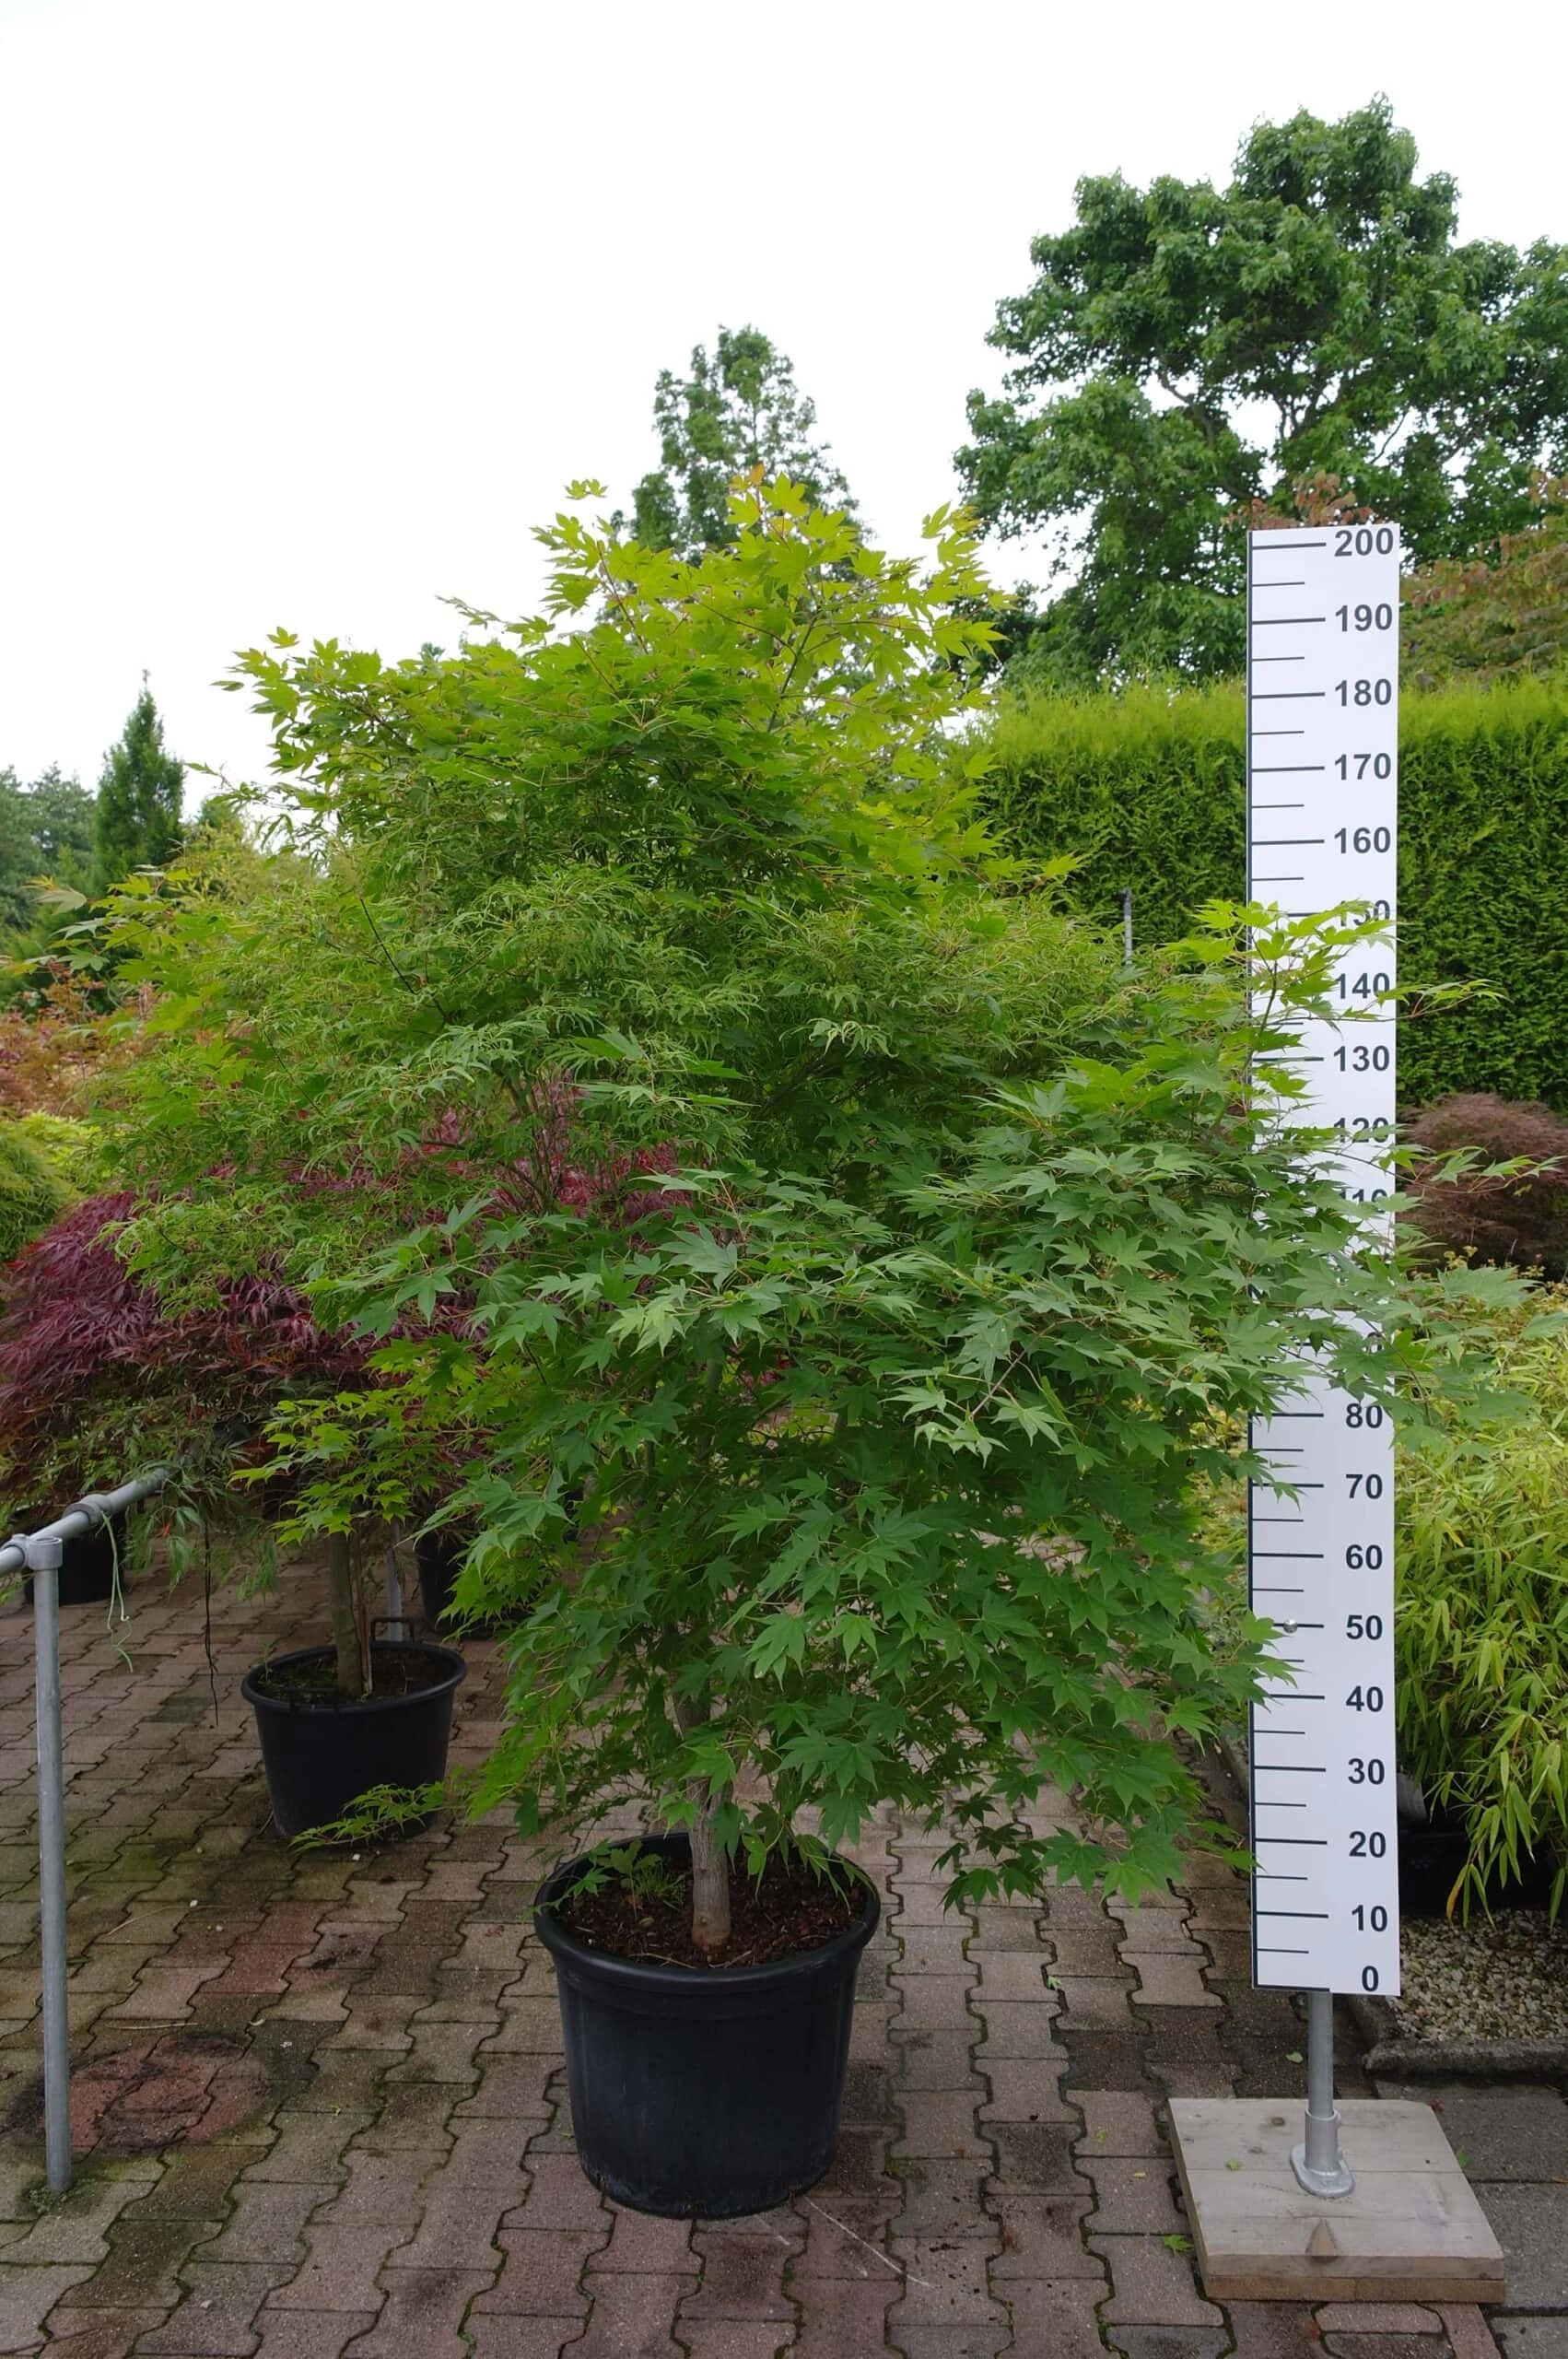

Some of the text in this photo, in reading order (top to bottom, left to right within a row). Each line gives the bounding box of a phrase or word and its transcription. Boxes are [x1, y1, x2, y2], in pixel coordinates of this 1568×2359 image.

[1334, 527, 1394, 557] 200
[1334, 604, 1392, 632] 190
[1334, 678, 1392, 707] 180
[1334, 753, 1391, 781] 170
[1334, 827, 1391, 854] 160
[1335, 972, 1390, 999] 140
[1333, 1045, 1390, 1072] 130
[1345, 1402, 1383, 1429] 80
[1345, 1473, 1383, 1500] 70
[1345, 1543, 1383, 1570] 60
[1346, 1614, 1383, 1640] 50
[1345, 1685, 1384, 1712] 40
[1347, 1757, 1386, 1785] 30
[1348, 1830, 1387, 1858] 20
[1351, 1904, 1388, 1931] 10
[1361, 1966, 1379, 1992] 0
